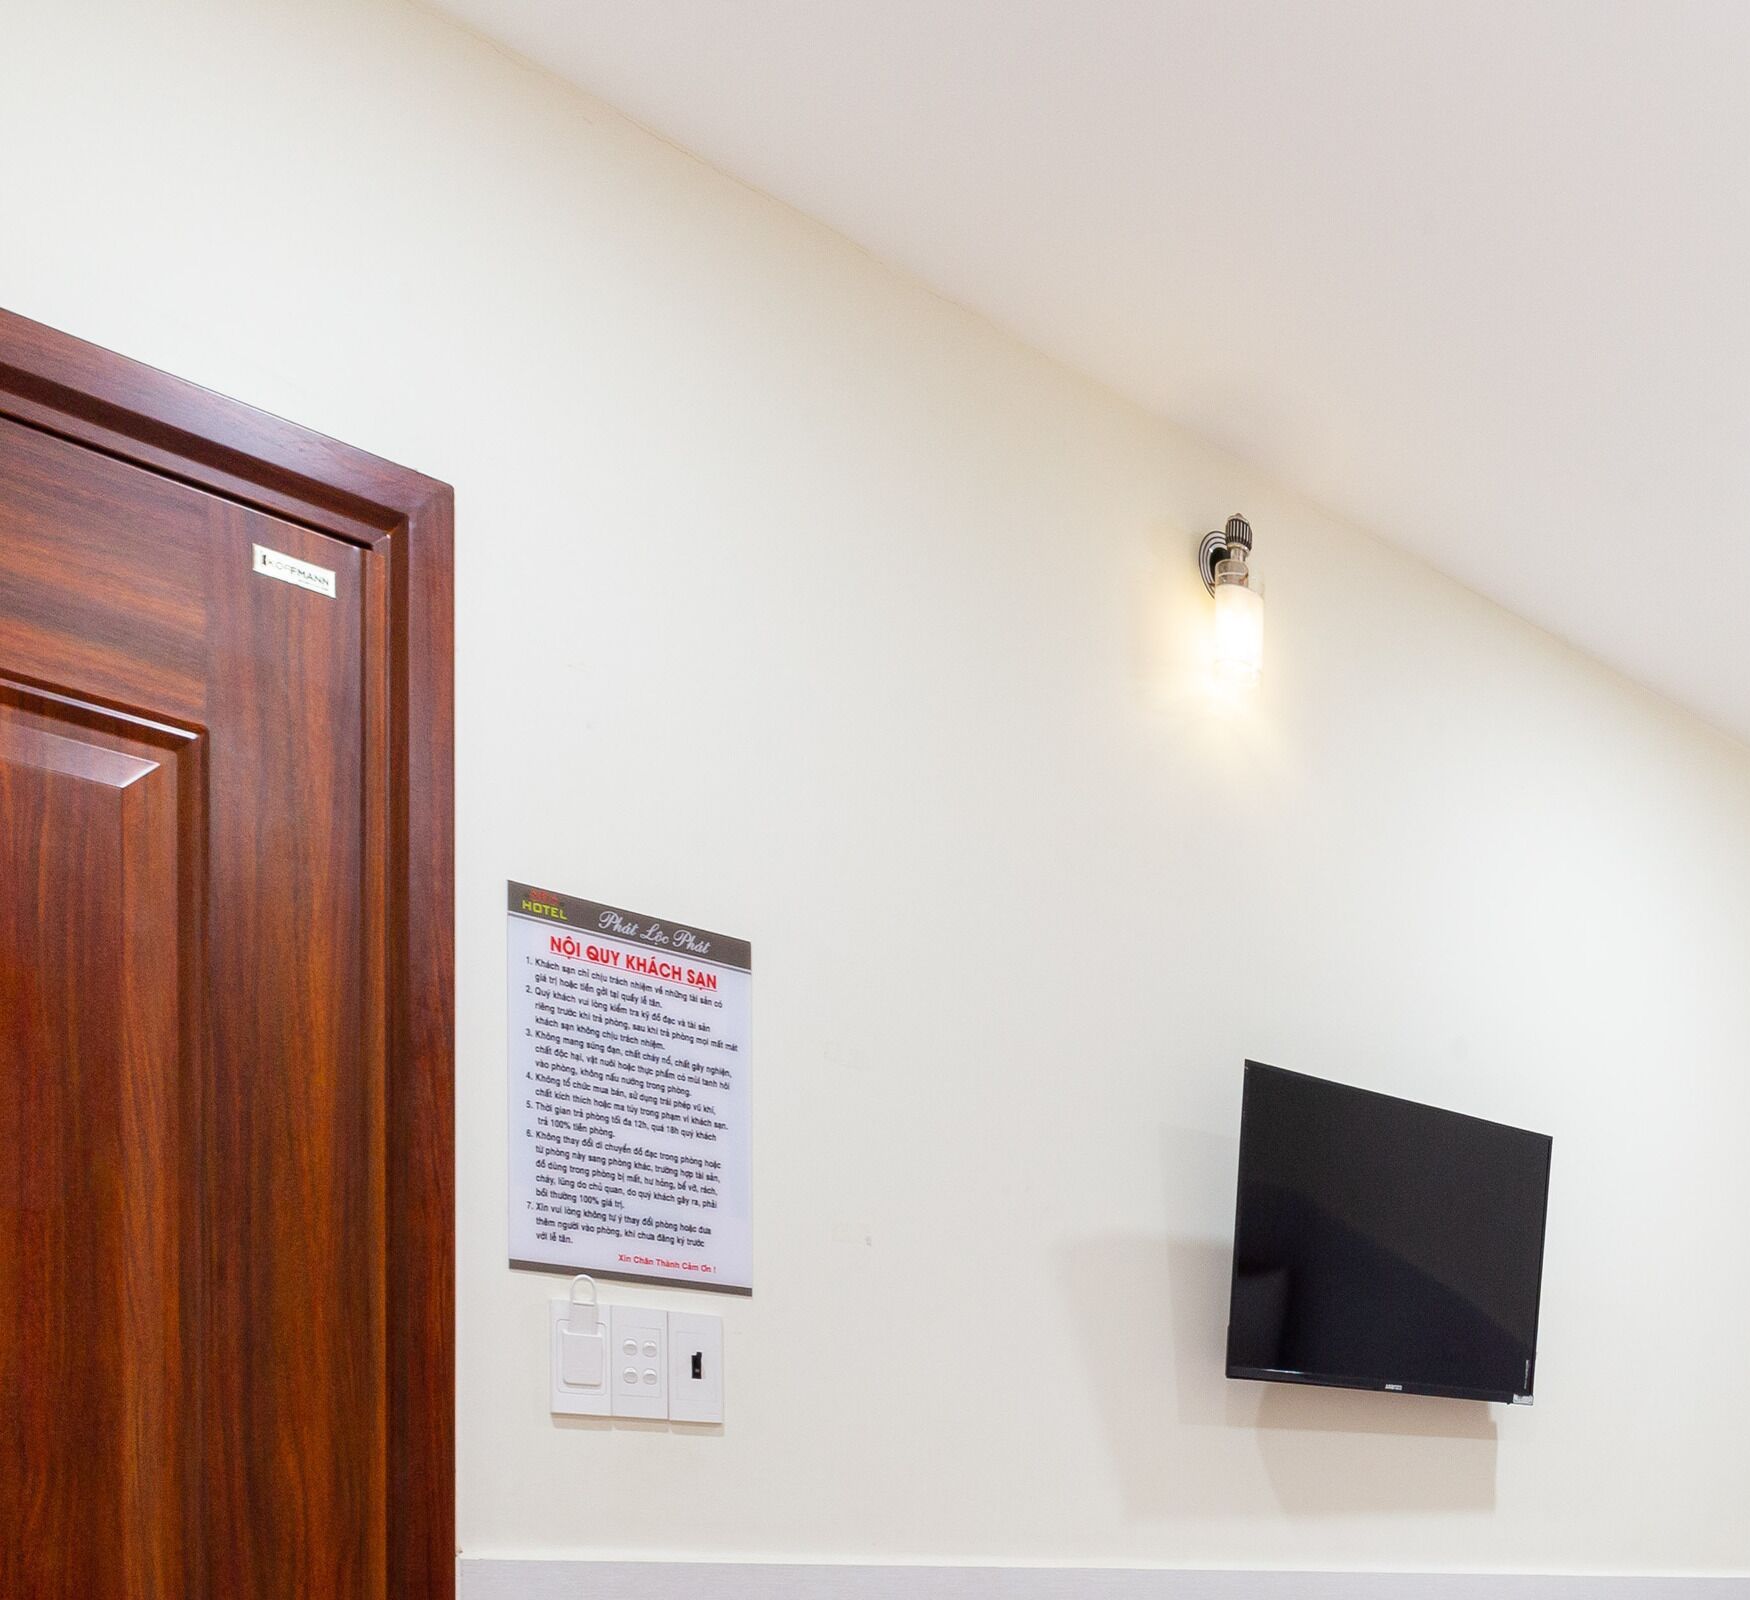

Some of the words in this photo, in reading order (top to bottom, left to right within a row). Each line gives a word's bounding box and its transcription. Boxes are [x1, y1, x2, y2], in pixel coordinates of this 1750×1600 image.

[522, 901, 568, 920] HOTEL
[598, 911, 637, 936] Phát
[640, 924, 670, 945] Lộc
[673, 932, 709, 954] Phát
[549, 936, 580, 961] NỘI
[586, 946, 621, 966] QUY
[626, 952, 682, 979] KHÁCH
[687, 968, 717, 992] SẠN
